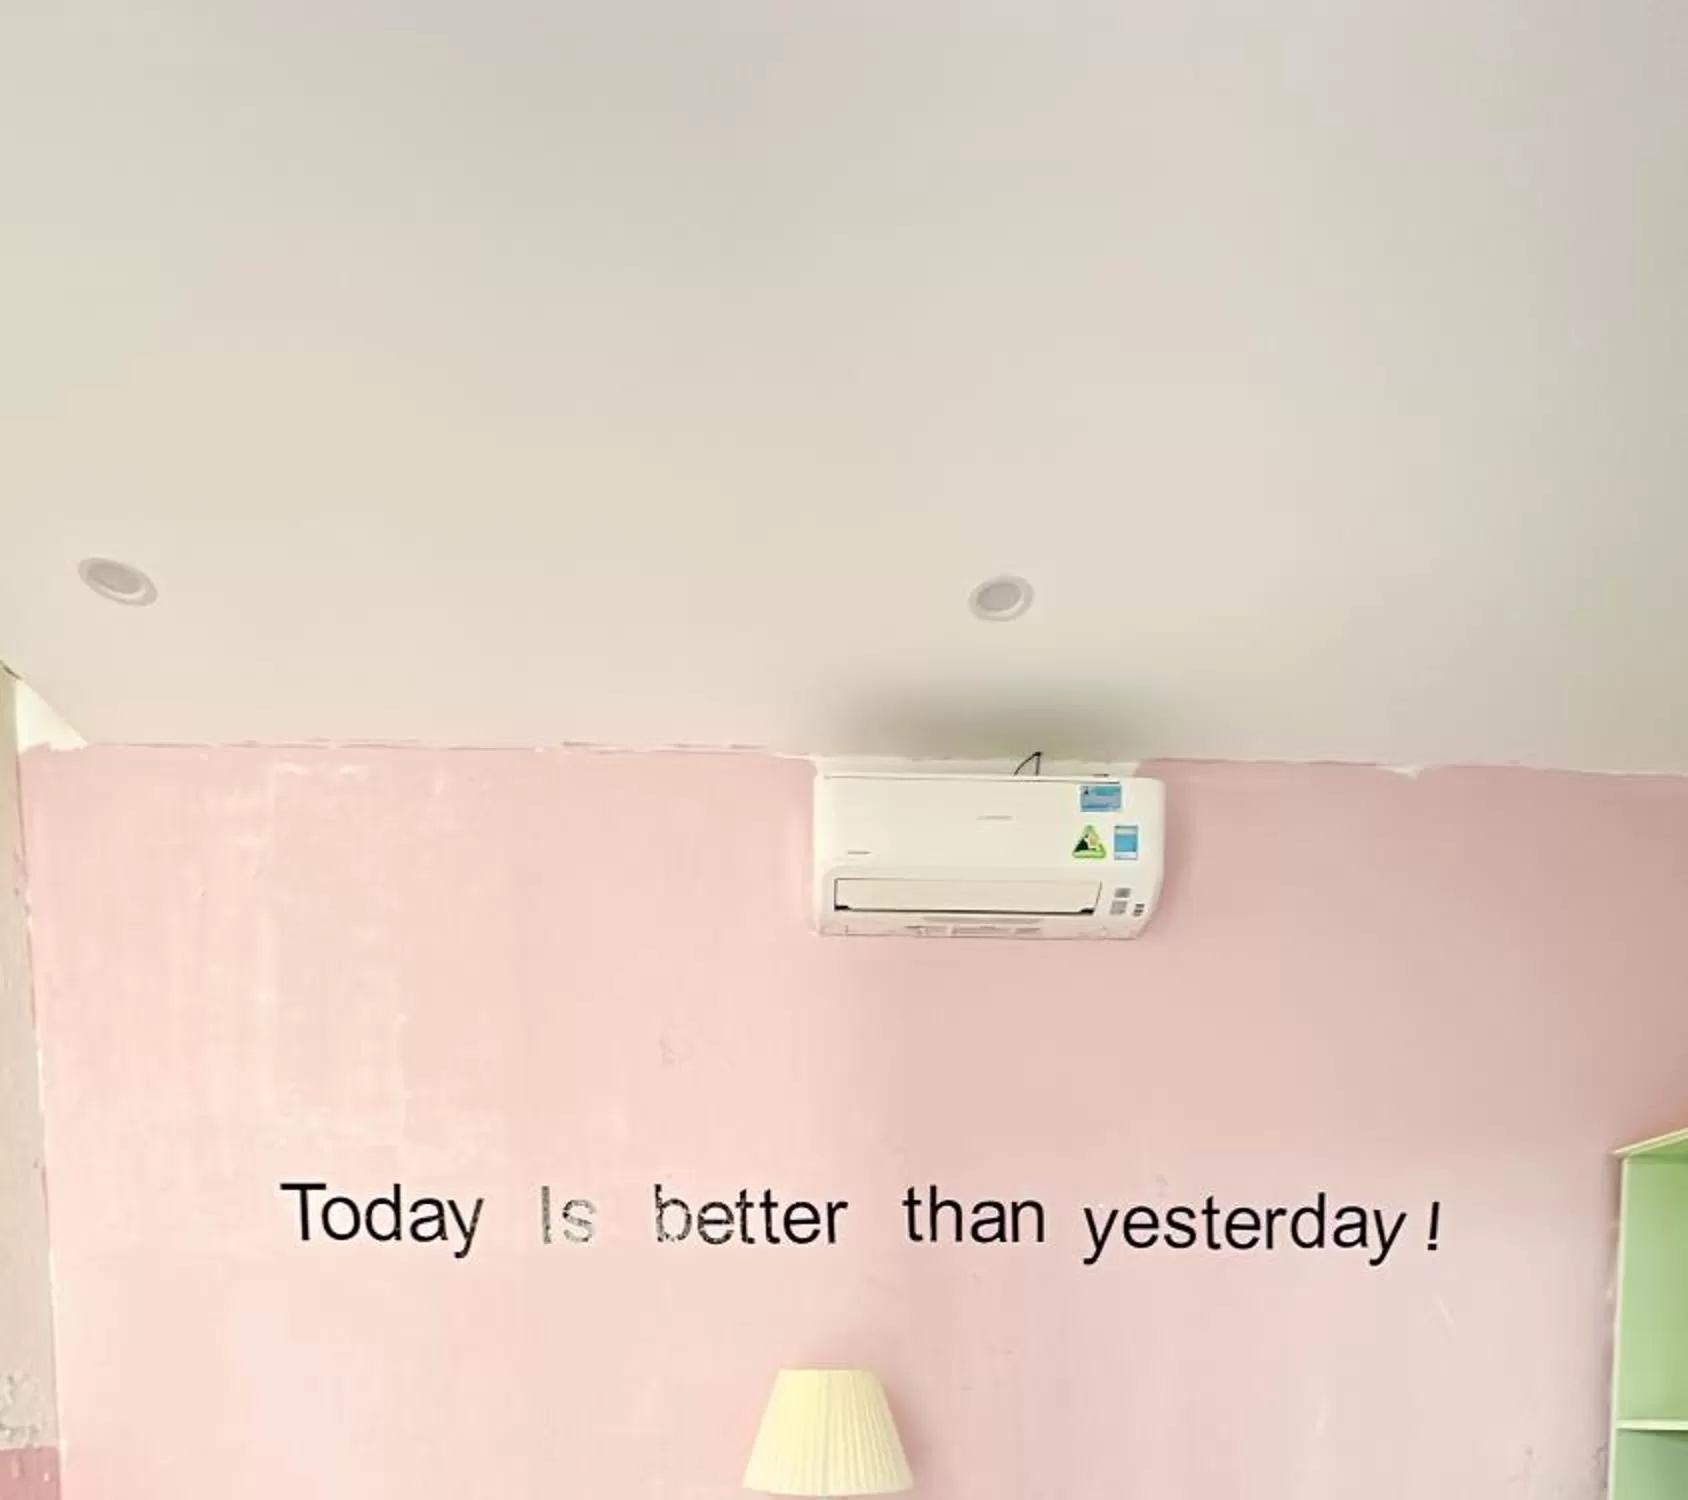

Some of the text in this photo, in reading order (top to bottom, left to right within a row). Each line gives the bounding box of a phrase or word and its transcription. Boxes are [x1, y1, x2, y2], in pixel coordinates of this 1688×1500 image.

[279, 1183, 484, 1259] Today
[654, 1183, 849, 1245] better
[902, 1184, 1045, 1244] than
